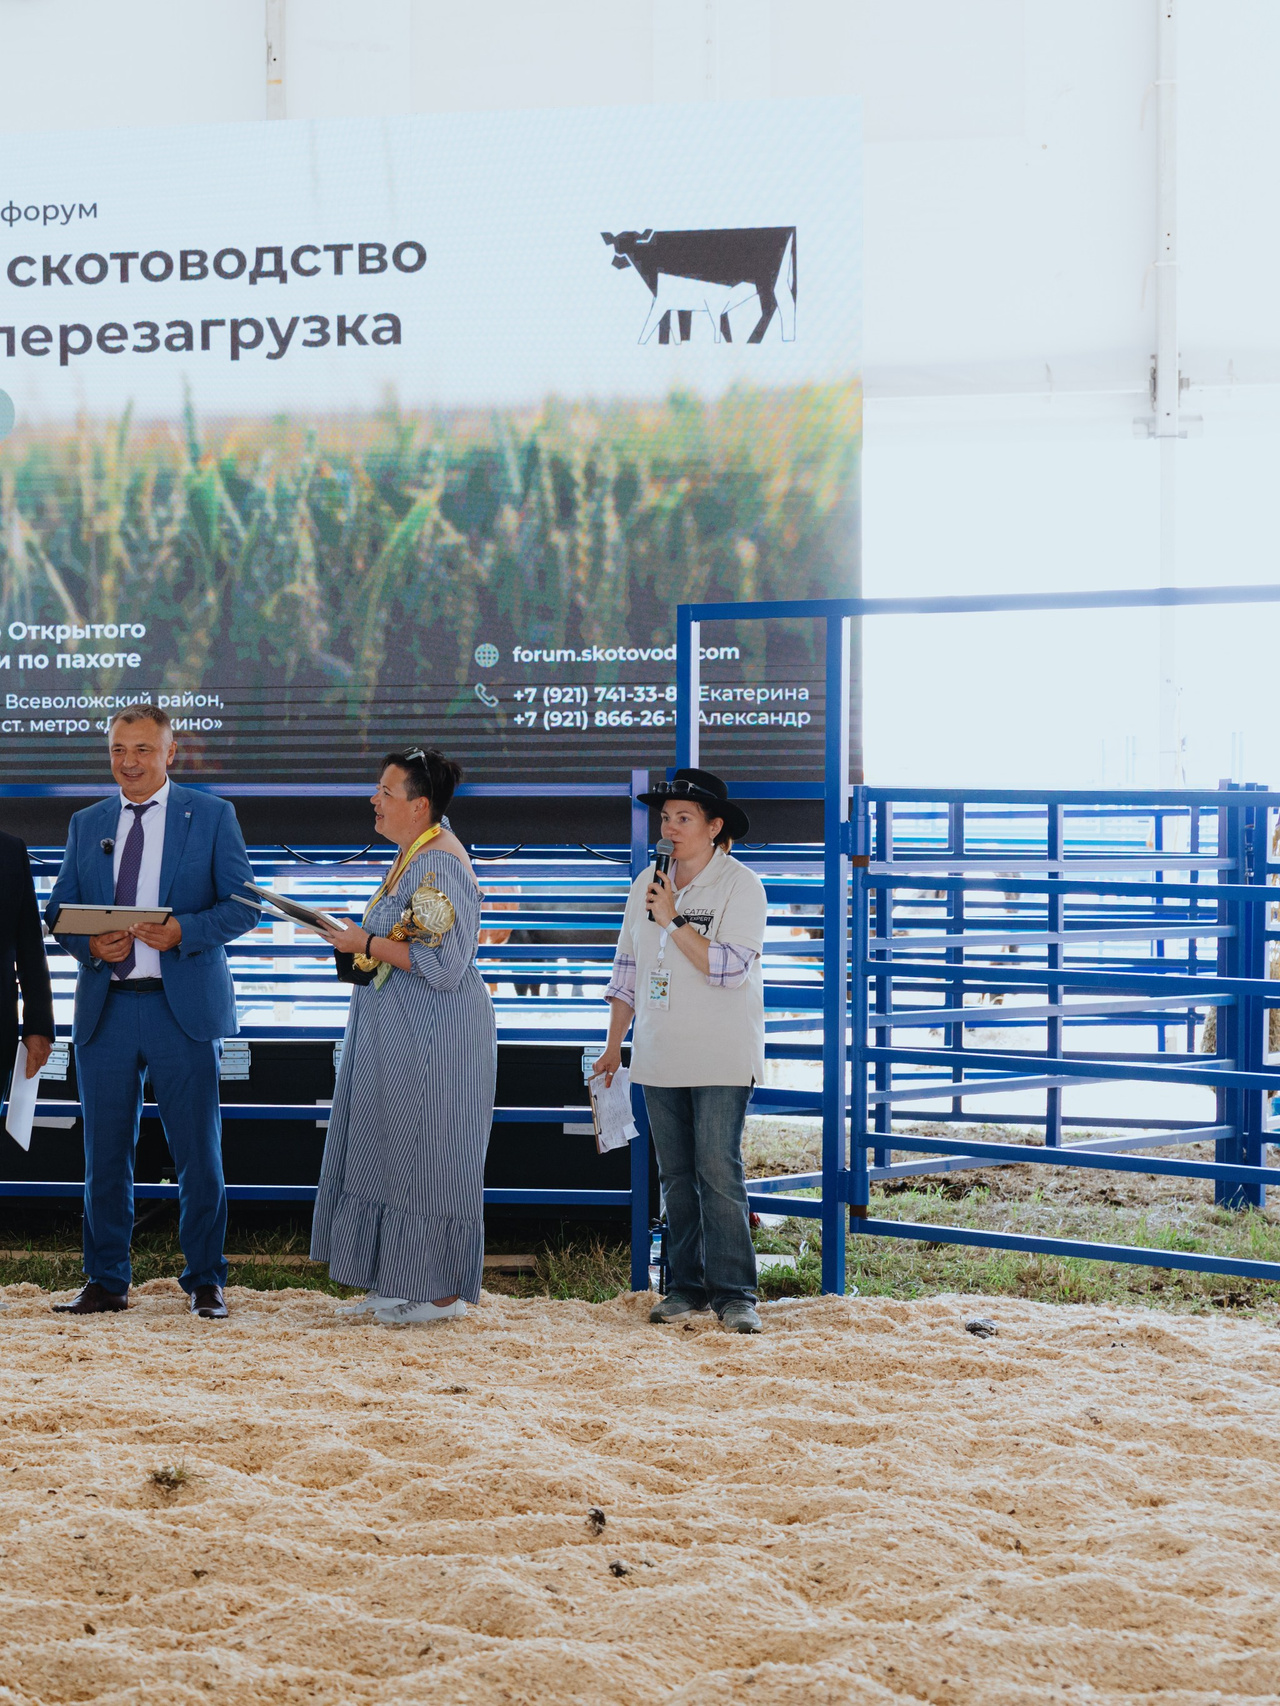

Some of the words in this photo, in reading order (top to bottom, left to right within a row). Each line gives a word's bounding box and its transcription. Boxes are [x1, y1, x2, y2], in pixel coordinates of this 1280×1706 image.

[0, 201, 97, 227] форум
[6, 240, 427, 287] скотоводство
[8, 621, 146, 644] Открытого
[18, 655, 49, 670] по
[56, 651, 142, 669] пахоте
[5, 691, 152, 708] Всеволожский
[157, 691, 224, 710] район,
[513, 687, 537, 703] +7
[543, 685, 588, 706] (921)
[594, 685, 677, 702] 741-33-8
[699, 685, 810, 705] Екатерина
[1, 719, 25, 733] ст.
[30, 718, 90, 737] метро
[513, 711, 538, 727] +7
[543, 709, 589, 730] (921)
[594, 709, 677, 726] 866-26-1
[699, 709, 812, 729] Александр
